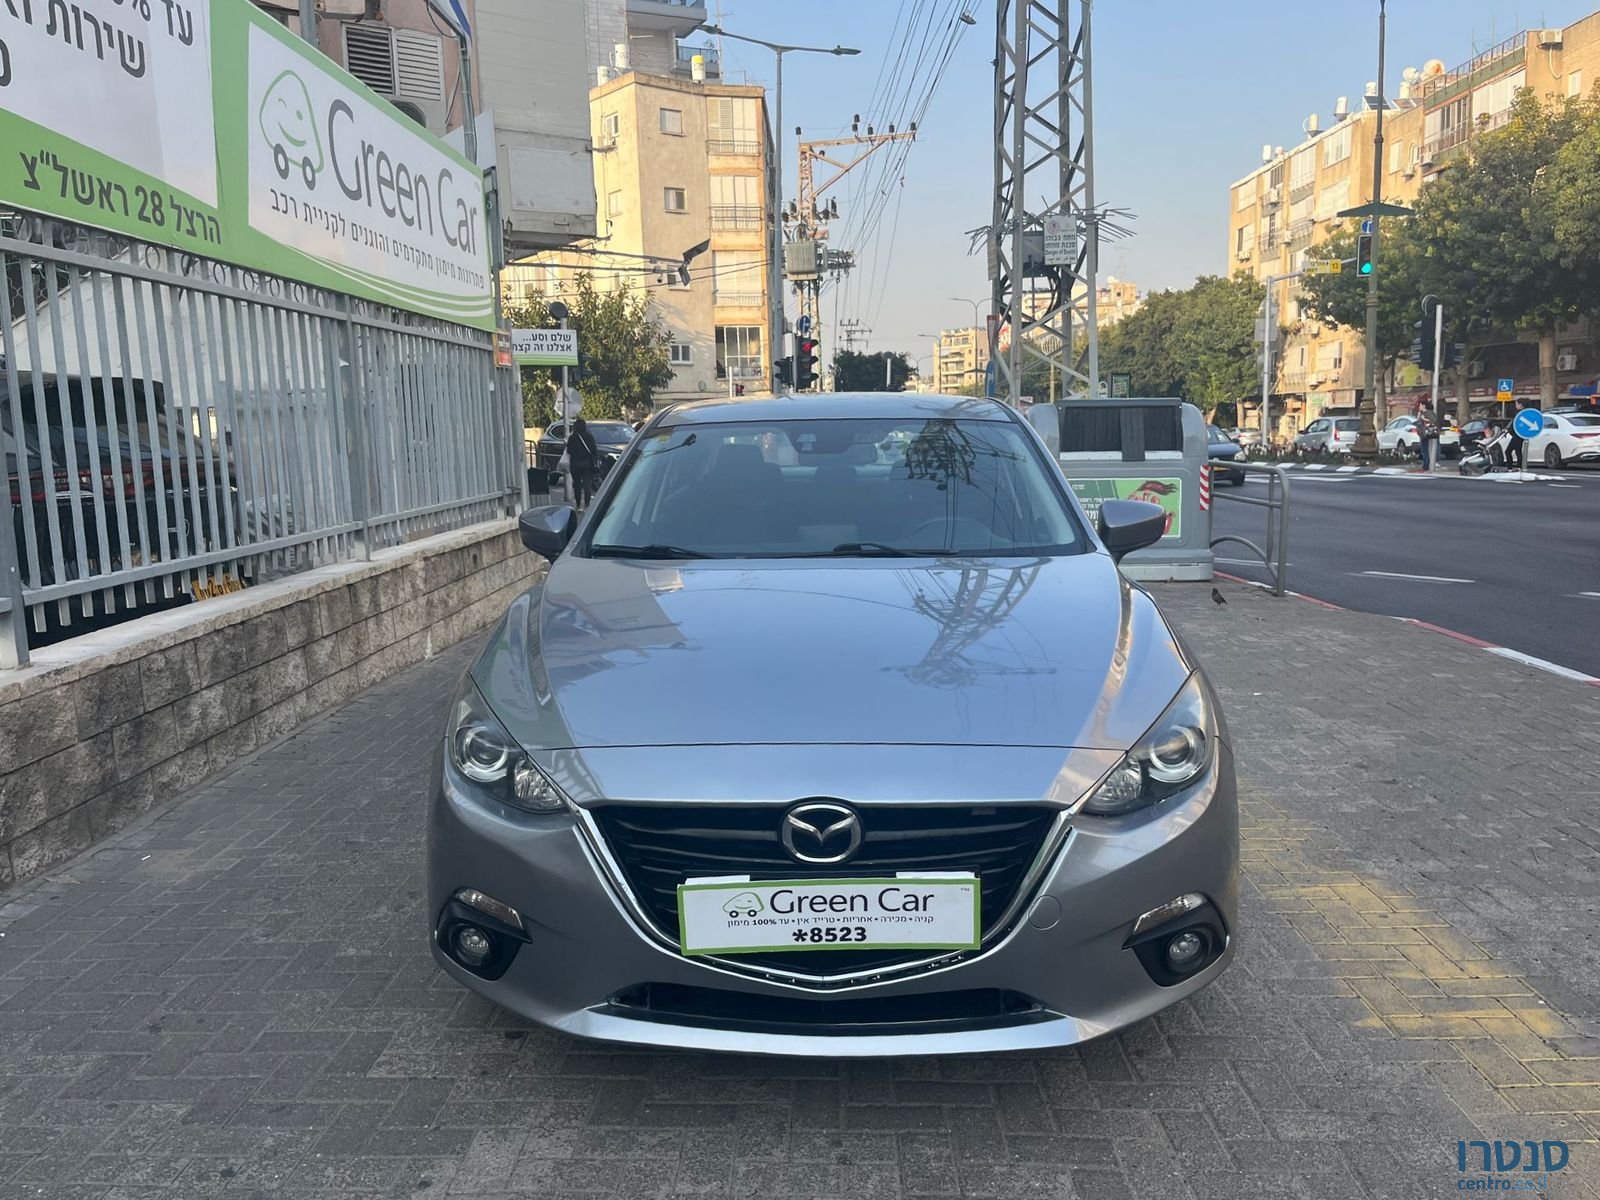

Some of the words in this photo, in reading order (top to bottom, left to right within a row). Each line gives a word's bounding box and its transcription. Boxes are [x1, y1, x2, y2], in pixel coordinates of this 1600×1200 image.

[46, 0, 146, 78] שירות
[328, 99, 433, 236] Green
[437, 168, 478, 256] Car
[134, 185, 165, 226] 28
[270, 188, 298, 219] רכב
[169, 194, 222, 245] הרצל
[303, 201, 346, 240] לקניית
[351, 222, 390, 253] והוגנים
[392, 238, 433, 270] מתקדמים
[435, 256, 456, 278] מימון
[533, 343, 544, 352] זה
[546, 342, 572, 352] אצלנו
[550, 332, 572, 342] שלם
[769, 889, 868, 914] Green
[878, 887, 935, 912] Car
[727, 919, 750, 928] מימון
[753, 918, 777, 926] 100%
[797, 917, 810, 926] אין
[812, 916, 835, 924] טרייד
[914, 916, 934, 924] קניה
